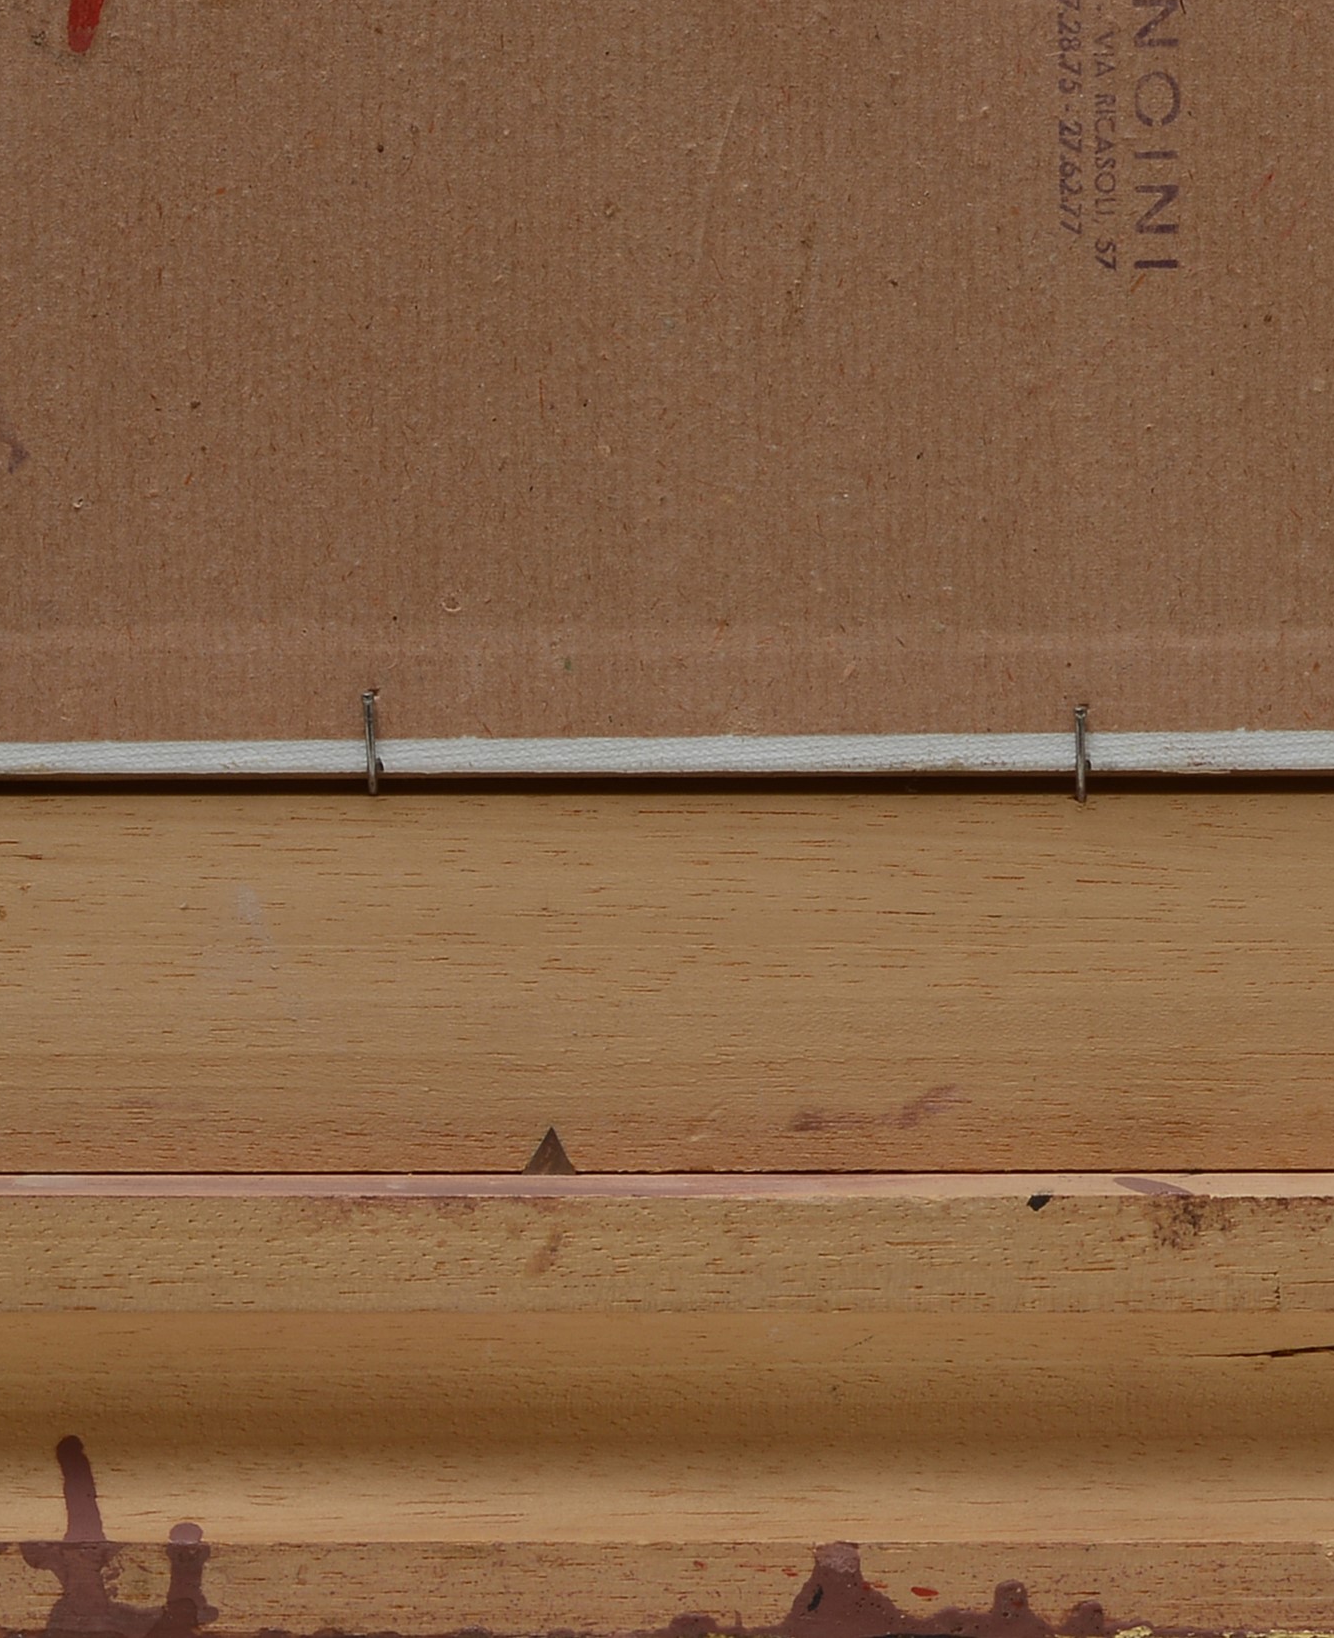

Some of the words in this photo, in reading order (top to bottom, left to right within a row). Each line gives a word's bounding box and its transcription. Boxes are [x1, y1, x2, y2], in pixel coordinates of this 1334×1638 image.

[1093, 31, 1116, 76] VIA
[1059, 118, 1084, 237] 27.62.77
[1093, 241, 1116, 272] 57
